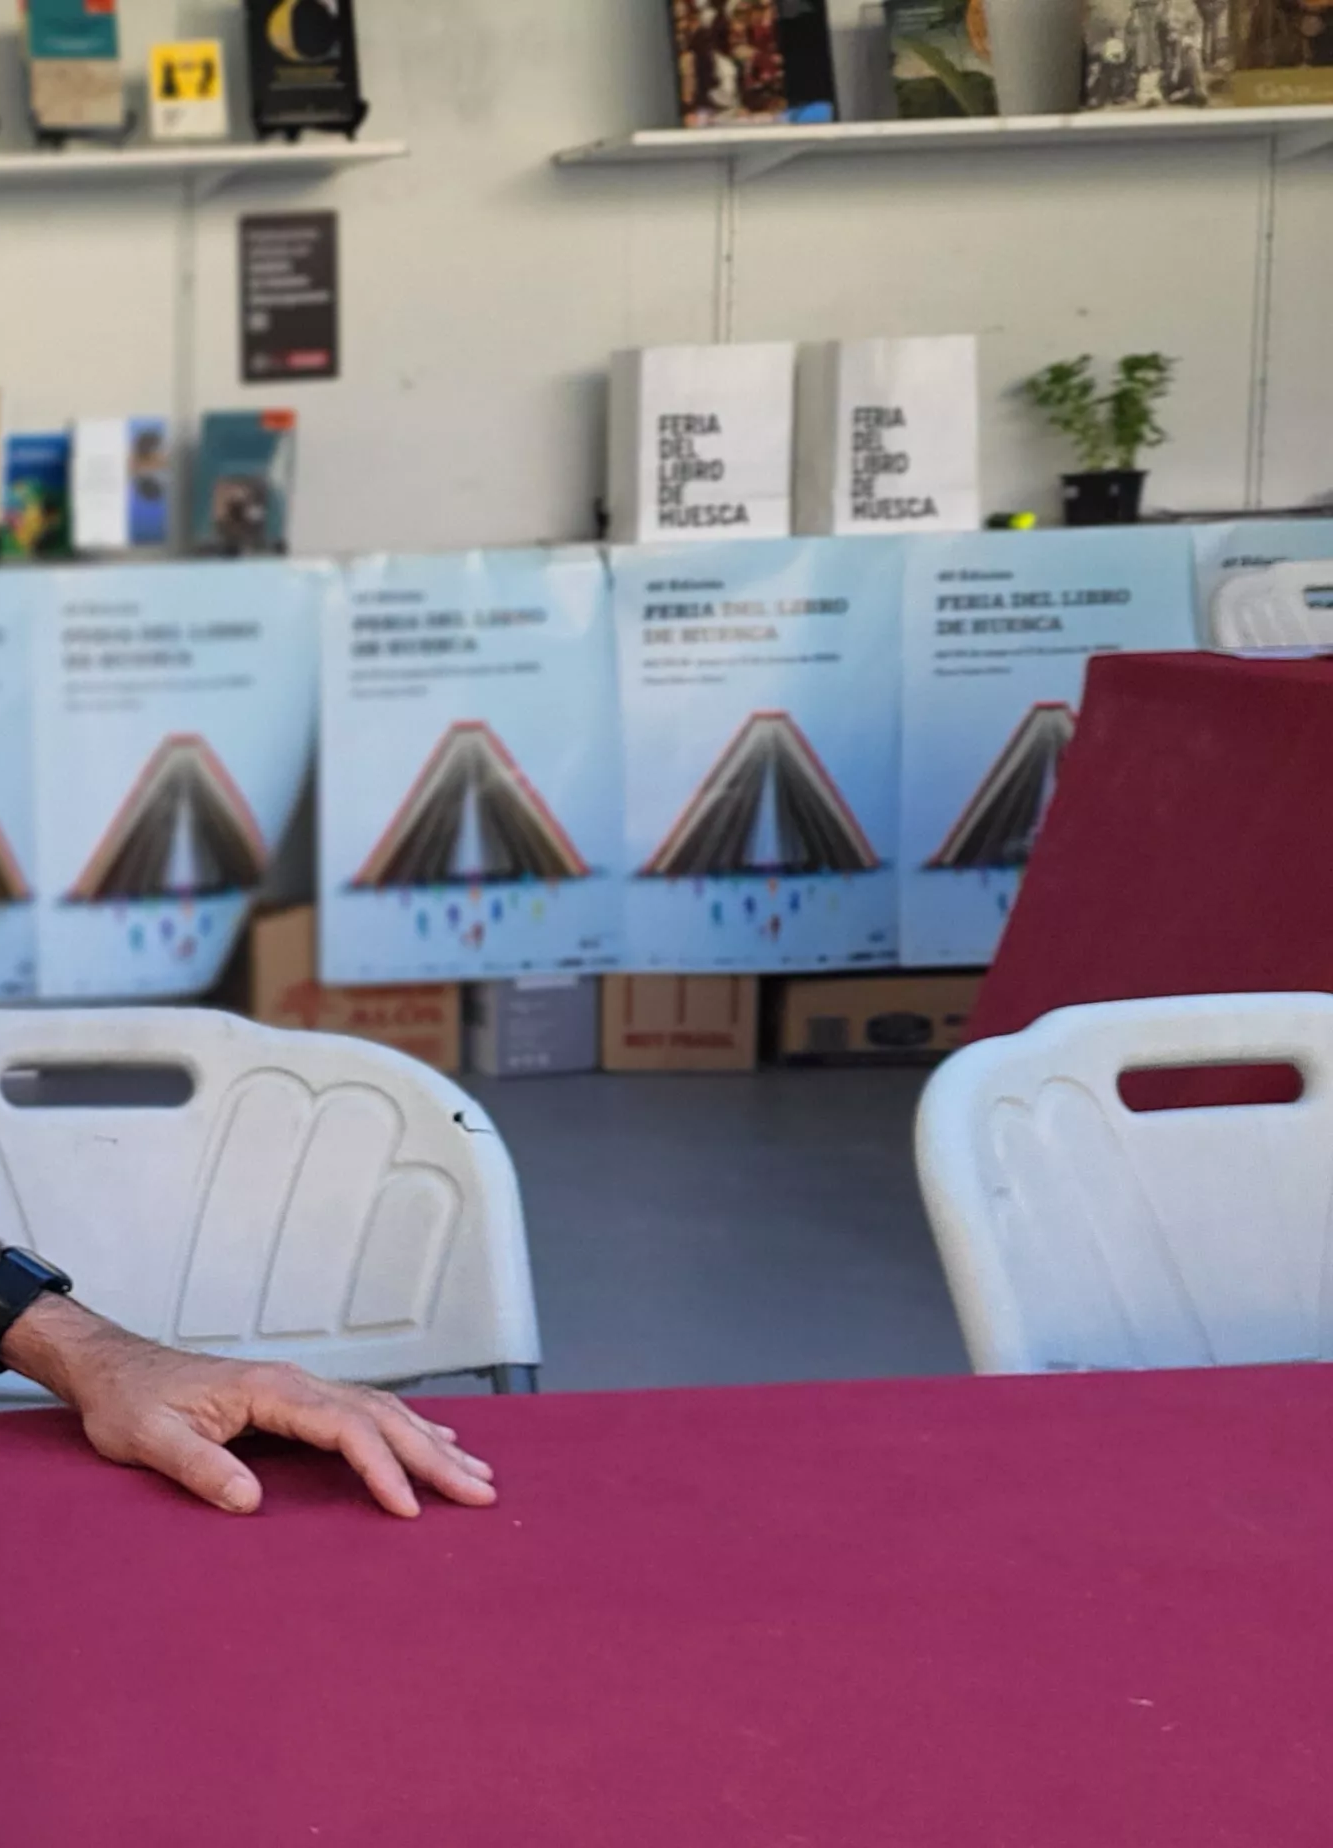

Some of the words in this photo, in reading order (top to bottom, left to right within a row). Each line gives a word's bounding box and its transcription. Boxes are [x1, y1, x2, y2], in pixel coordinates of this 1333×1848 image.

[658, 413, 722, 435] FERIA
[852, 406, 907, 429] FERIA
[658, 437, 700, 460] DEL
[852, 430, 885, 453] DEL
[658, 458, 725, 482] LIBRO
[852, 450, 911, 475] LIBRO
[658, 482, 683, 505] DE
[851, 476, 875, 498] DE
[658, 502, 750, 528] HUESCA
[852, 496, 940, 520] HUESCA
